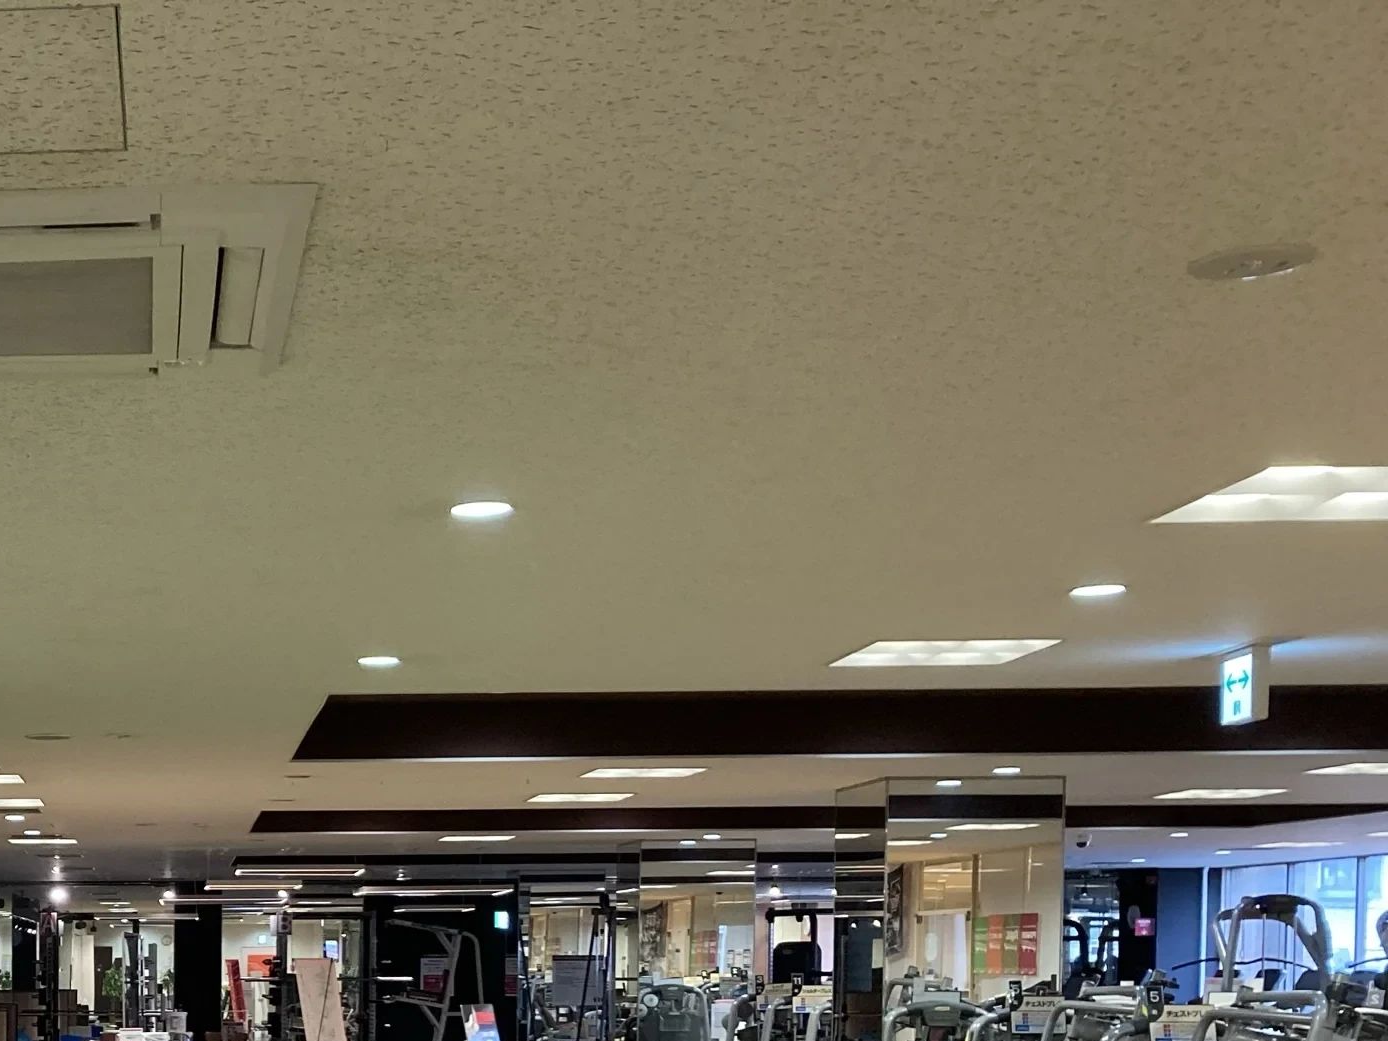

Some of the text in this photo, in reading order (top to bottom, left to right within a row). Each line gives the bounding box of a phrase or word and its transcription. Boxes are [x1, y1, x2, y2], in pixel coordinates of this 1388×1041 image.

[1150, 991, 1160, 1002] 5
[1166, 1010, 1204, 1018] チェストプレ
